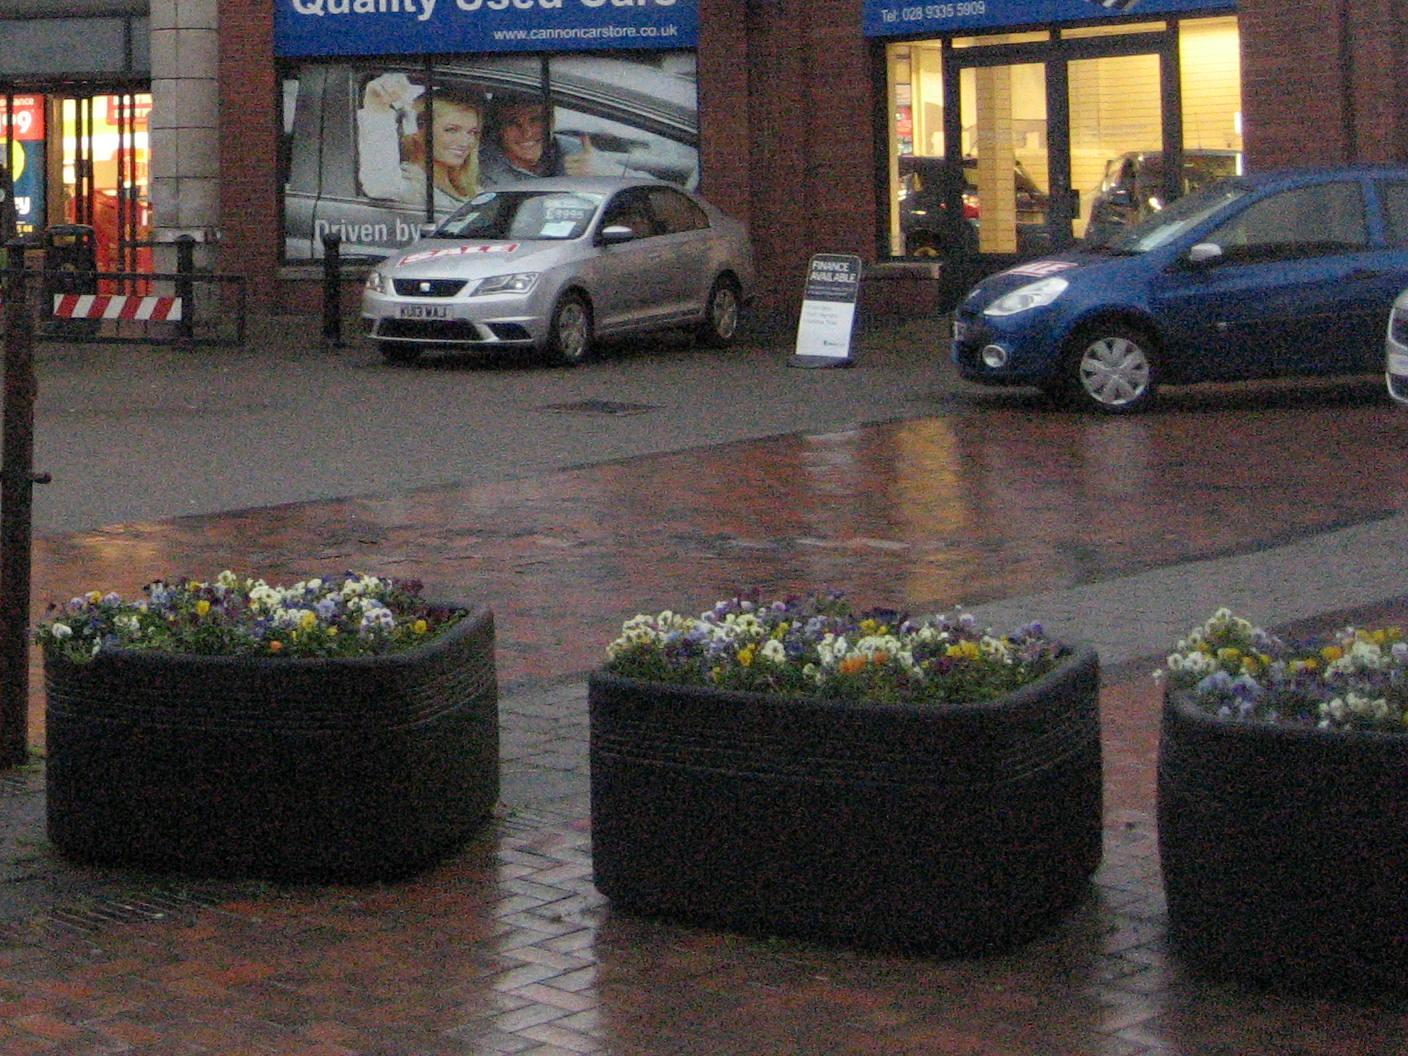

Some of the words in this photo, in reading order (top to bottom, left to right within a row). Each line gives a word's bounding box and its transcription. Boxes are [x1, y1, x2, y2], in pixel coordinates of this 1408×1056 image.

[903, 5, 922, 21] 028
[494, 24, 678, 41] www.cannoncarstore.co.uk
[396, 217, 422, 243] by
